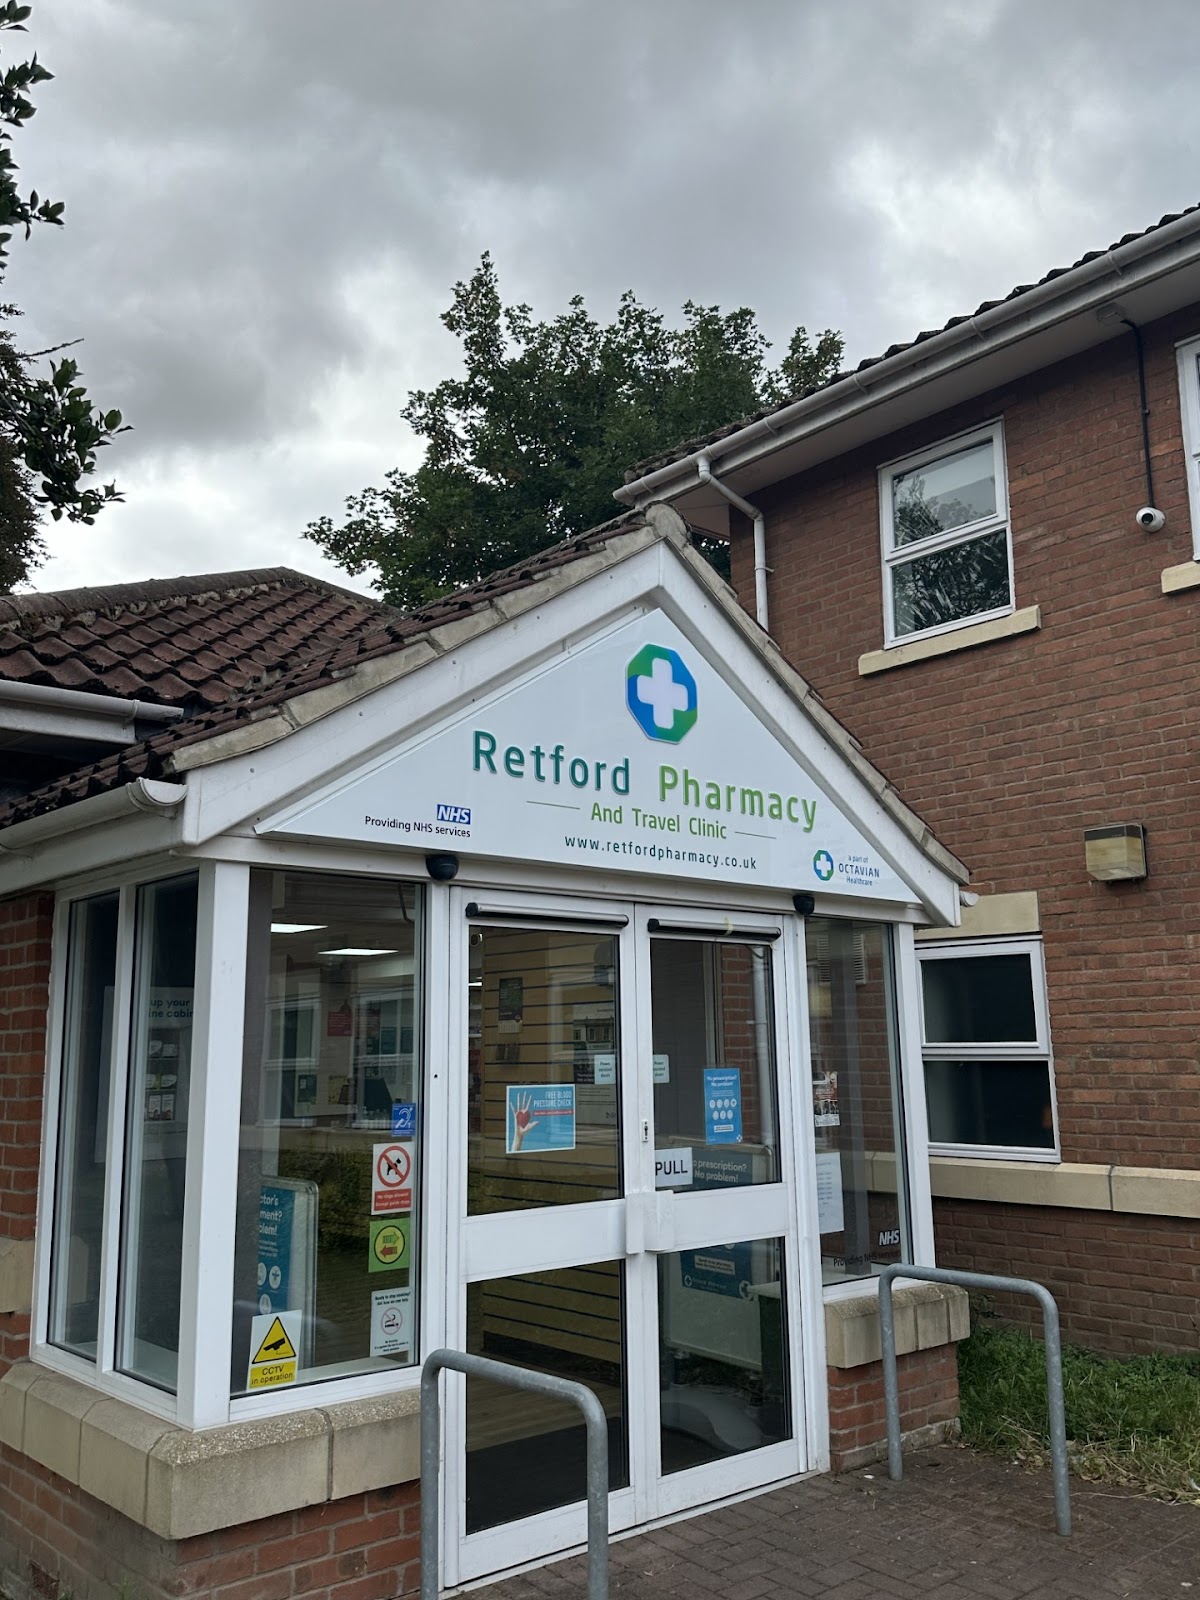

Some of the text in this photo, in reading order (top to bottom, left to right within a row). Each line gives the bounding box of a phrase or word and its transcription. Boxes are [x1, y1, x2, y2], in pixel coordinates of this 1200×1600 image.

[473, 730, 818, 834] Retford Pharmacy
[438, 805, 470, 824] NHS
[591, 802, 728, 840] And Travel Clinic
[365, 816, 471, 838] Providing NHS services
[565, 834, 757, 870] www.retfordpharmacy.co.uk
[838, 863, 880, 878] OCTAVIAN
[846, 876, 873, 886] Healthcare
[166, 1000, 190, 1009] your
[545, 1090, 557, 1099] FREE
[558, 1090, 572, 1099] BLOOD
[533, 1099, 556, 1108] PRESSURE
[557, 1099, 572, 1107] CHECK
[655, 1160, 688, 1176] PULL
[698, 1160, 747, 1172] prescription?
[694, 1170, 739, 1183] No problem!
[879, 1229, 900, 1246] NHS
[833, 1254, 863, 1267] Providing
[864, 1253, 877, 1262] NHS
[262, 1365, 285, 1375] CCTV
[260, 1372, 293, 1384] operation
